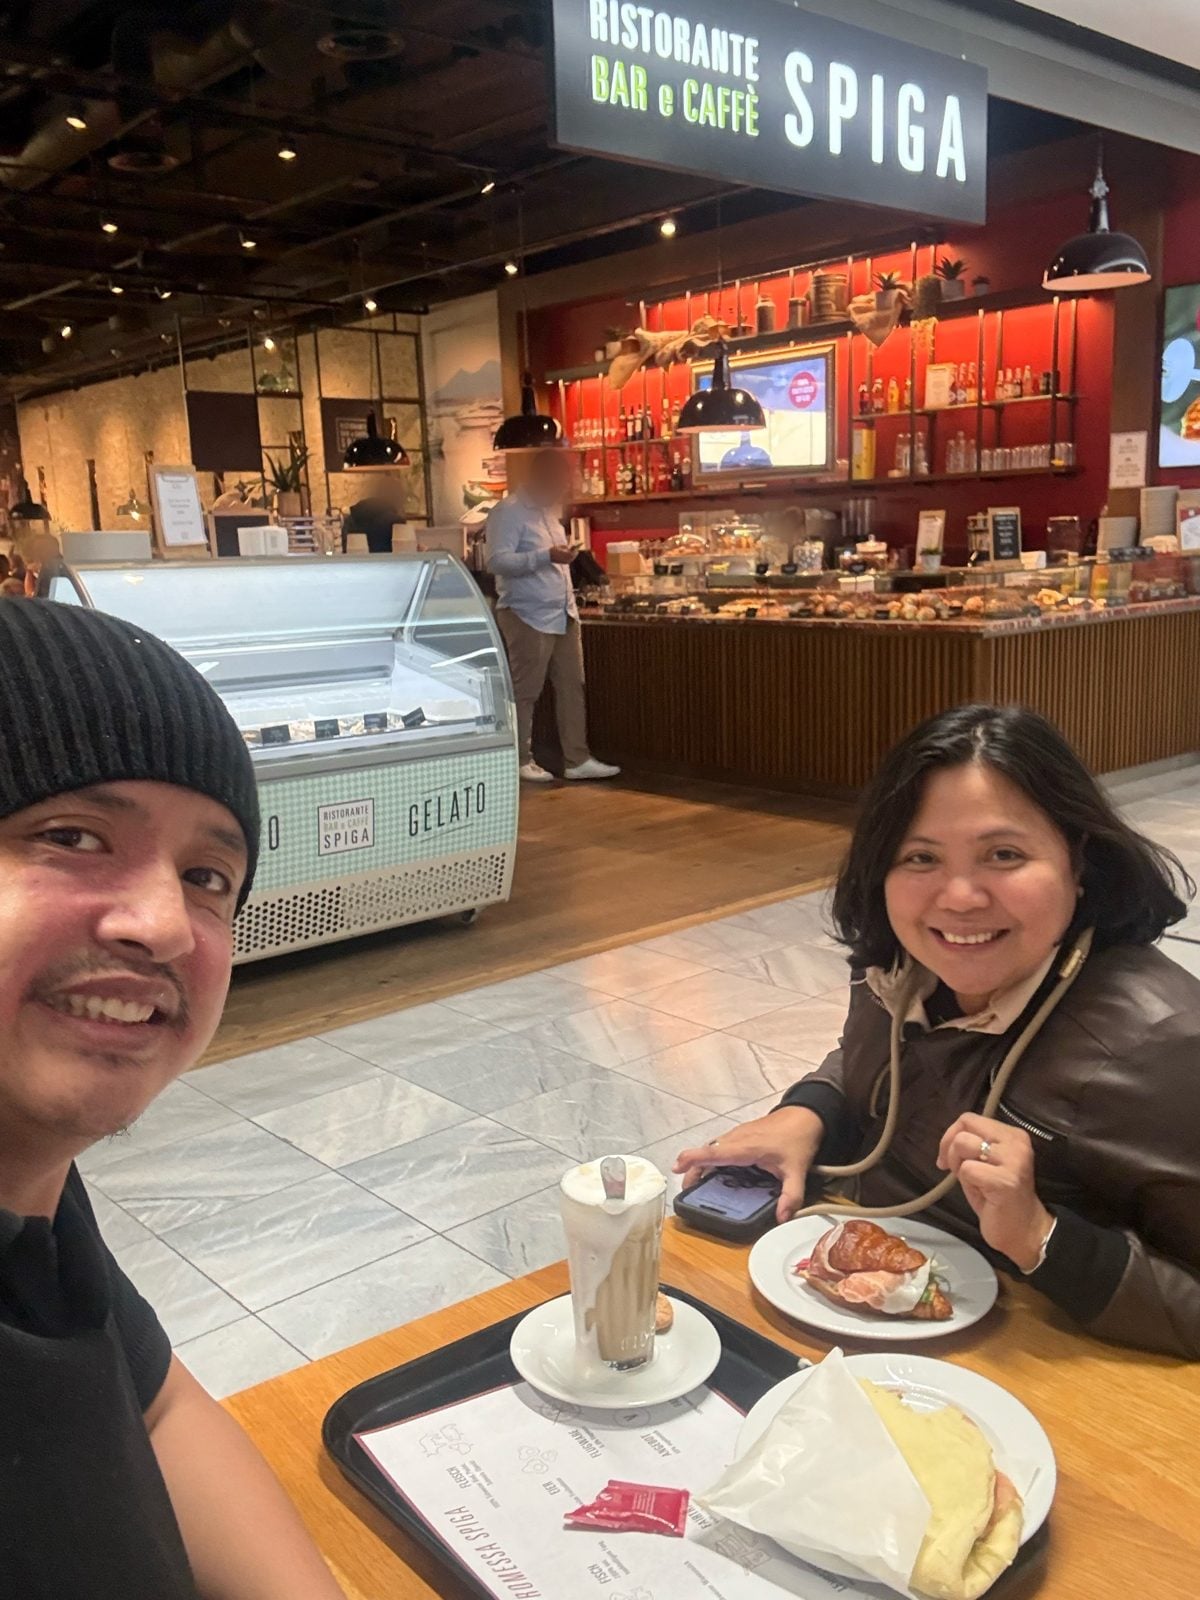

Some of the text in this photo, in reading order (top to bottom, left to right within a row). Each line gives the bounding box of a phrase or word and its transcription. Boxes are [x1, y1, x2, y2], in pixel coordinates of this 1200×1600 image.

[589, 0, 760, 82] RISTORANTE
[591, 54, 760, 137] BAR e CAFFÈ
[784, 50, 967, 183] SPIGA
[323, 804, 370, 821] RISTORANTE
[408, 781, 486, 837] GELATO
[324, 827, 370, 849] SPIGA
[640, 1433, 672, 1457] ANGEBOT
[446, 1466, 472, 1489] FLEISCH
[542, 1481, 561, 1496] EIER
[443, 1505, 490, 1541] SPIGA
[474, 1542, 542, 1600] ROMESSA
[587, 1563, 612, 1584] FISCH
